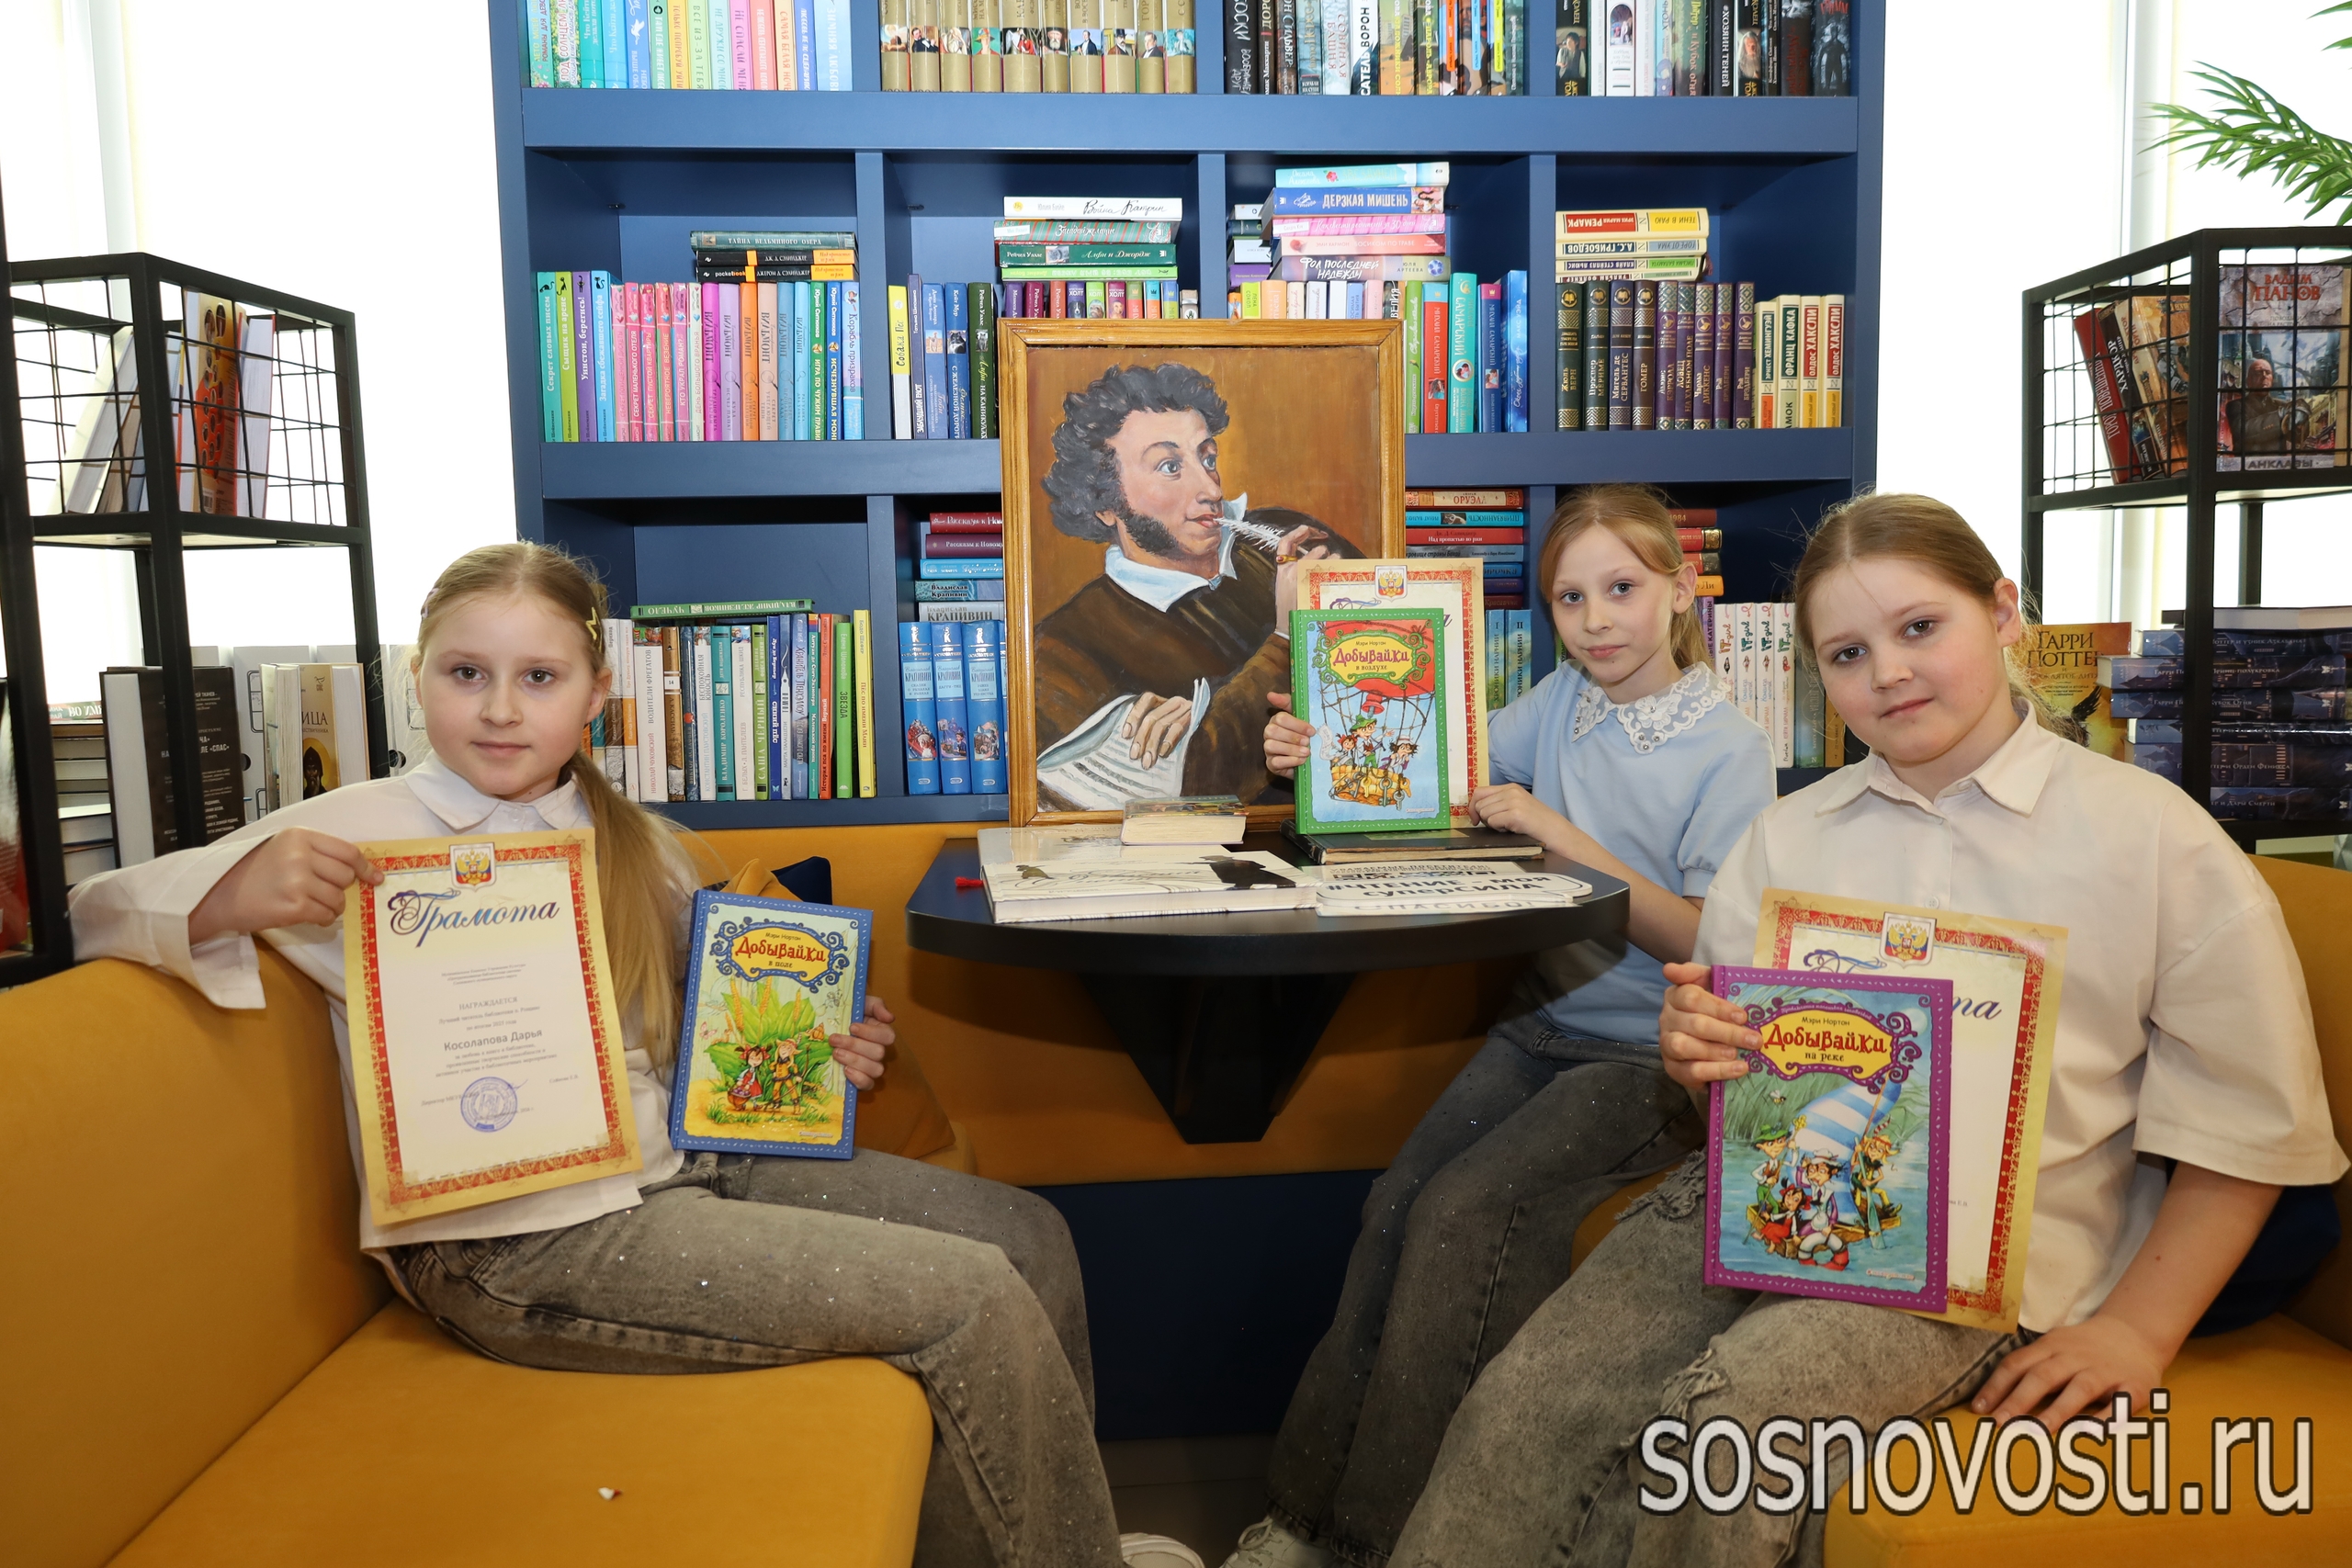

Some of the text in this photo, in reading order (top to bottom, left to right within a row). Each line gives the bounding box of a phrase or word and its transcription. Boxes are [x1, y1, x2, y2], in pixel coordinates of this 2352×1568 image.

[735, 10, 744, 20] НЕ
[780, 11, 790, 39] САМАЯ
[1360, 7, 1370, 47] ВОРОН
[559, 14, 570, 81] ПОД СОЛНЦЕМ
[735, 26, 746, 63] СПАСАЙ
[781, 43, 791, 68] БЕЛАЯ
[1327, 22, 1337, 70] БАШНЯ
[1336, 14, 1346, 78] СОВИНАЯ
[1721, 5, 1730, 87] #ХОЗЯИН ТЕНЕЙ
[1083, 199, 1167, 216] Война Катрин
[1323, 194, 1408, 209] ДЕРЗКАЯ МИШЕНЬ
[1568, 218, 1602, 227] РЕМАРК
[728, 237, 822, 246] ТАЙНА ВЕДЬМИНОГО ОЗЕРА
[1567, 243, 1633, 253] А.С. ГРИБОЕДОВ
[715, 270, 746, 278] pocketbook
[1317, 269, 1363, 279] НАДЕЖДЫ
[1324, 259, 1380, 270] ПОСЛЕДНЕЙ
[2255, 285, 2321, 302] ПАНОВ
[580, 297, 589, 380] Уинстон, берегись!
[1454, 297, 1466, 355] САМАРСКИЙ
[1764, 314, 1773, 358] ХЕМИНГУЭЙ
[1785, 310, 1796, 341] КАФКА
[1806, 309, 1817, 350] ХАКСЛИ
[595, 294, 607, 401] Загадка сбежавшего сейфа
[848, 313, 858, 393] Корабль призраков
[894, 320, 905, 367] Собака Пёс
[1829, 308, 1841, 375] ОЛДОС ХАКСЛИ
[1785, 343, 1796, 376] ФРАНЦ
[547, 361, 555, 392] Секрет
[814, 377, 821, 387] ПО
[1589, 359, 1597, 396] Проспер
[1612, 355, 1621, 399] Мигель де
[1621, 353, 1629, 402] СЕРВАНТЕС
[1676, 360, 1685, 388] ЛОВЕЦ
[1685, 401, 1692, 412] НА
[1453, 496, 1487, 504] ОРУЭЛЛ
[1668, 513, 1686, 522] 1984
[648, 601, 796, 615] ВЛАДИМИР ЖЕЛЕЗНИКОВ ЧУЧЕЛО
[927, 610, 993, 621] КРАПИВИН
[2037, 631, 2094, 650] ГАРРИ
[1333, 647, 1410, 666] Добывайки
[839, 691, 848, 718] ЗВЕЗДА
[755, 699, 766, 780] САША ЧЁРНЫЙ
[1326, 879, 1463, 891] #ЧТЕНИЕ
[1363, 882, 1544, 897] суперСИЛА
[388, 888, 560, 948] Грамота
[735, 937, 826, 963] Добывайки
[458, 997, 518, 1011] НАГРАЖДАЕТСЯ
[1801, 1016, 1850, 1027] Мэри Нортон
[444, 1029, 543, 1052] Косолапова Дарья
[1764, 1023, 1887, 1054] Добывайки
[1820, 1053, 1844, 1062] реке
